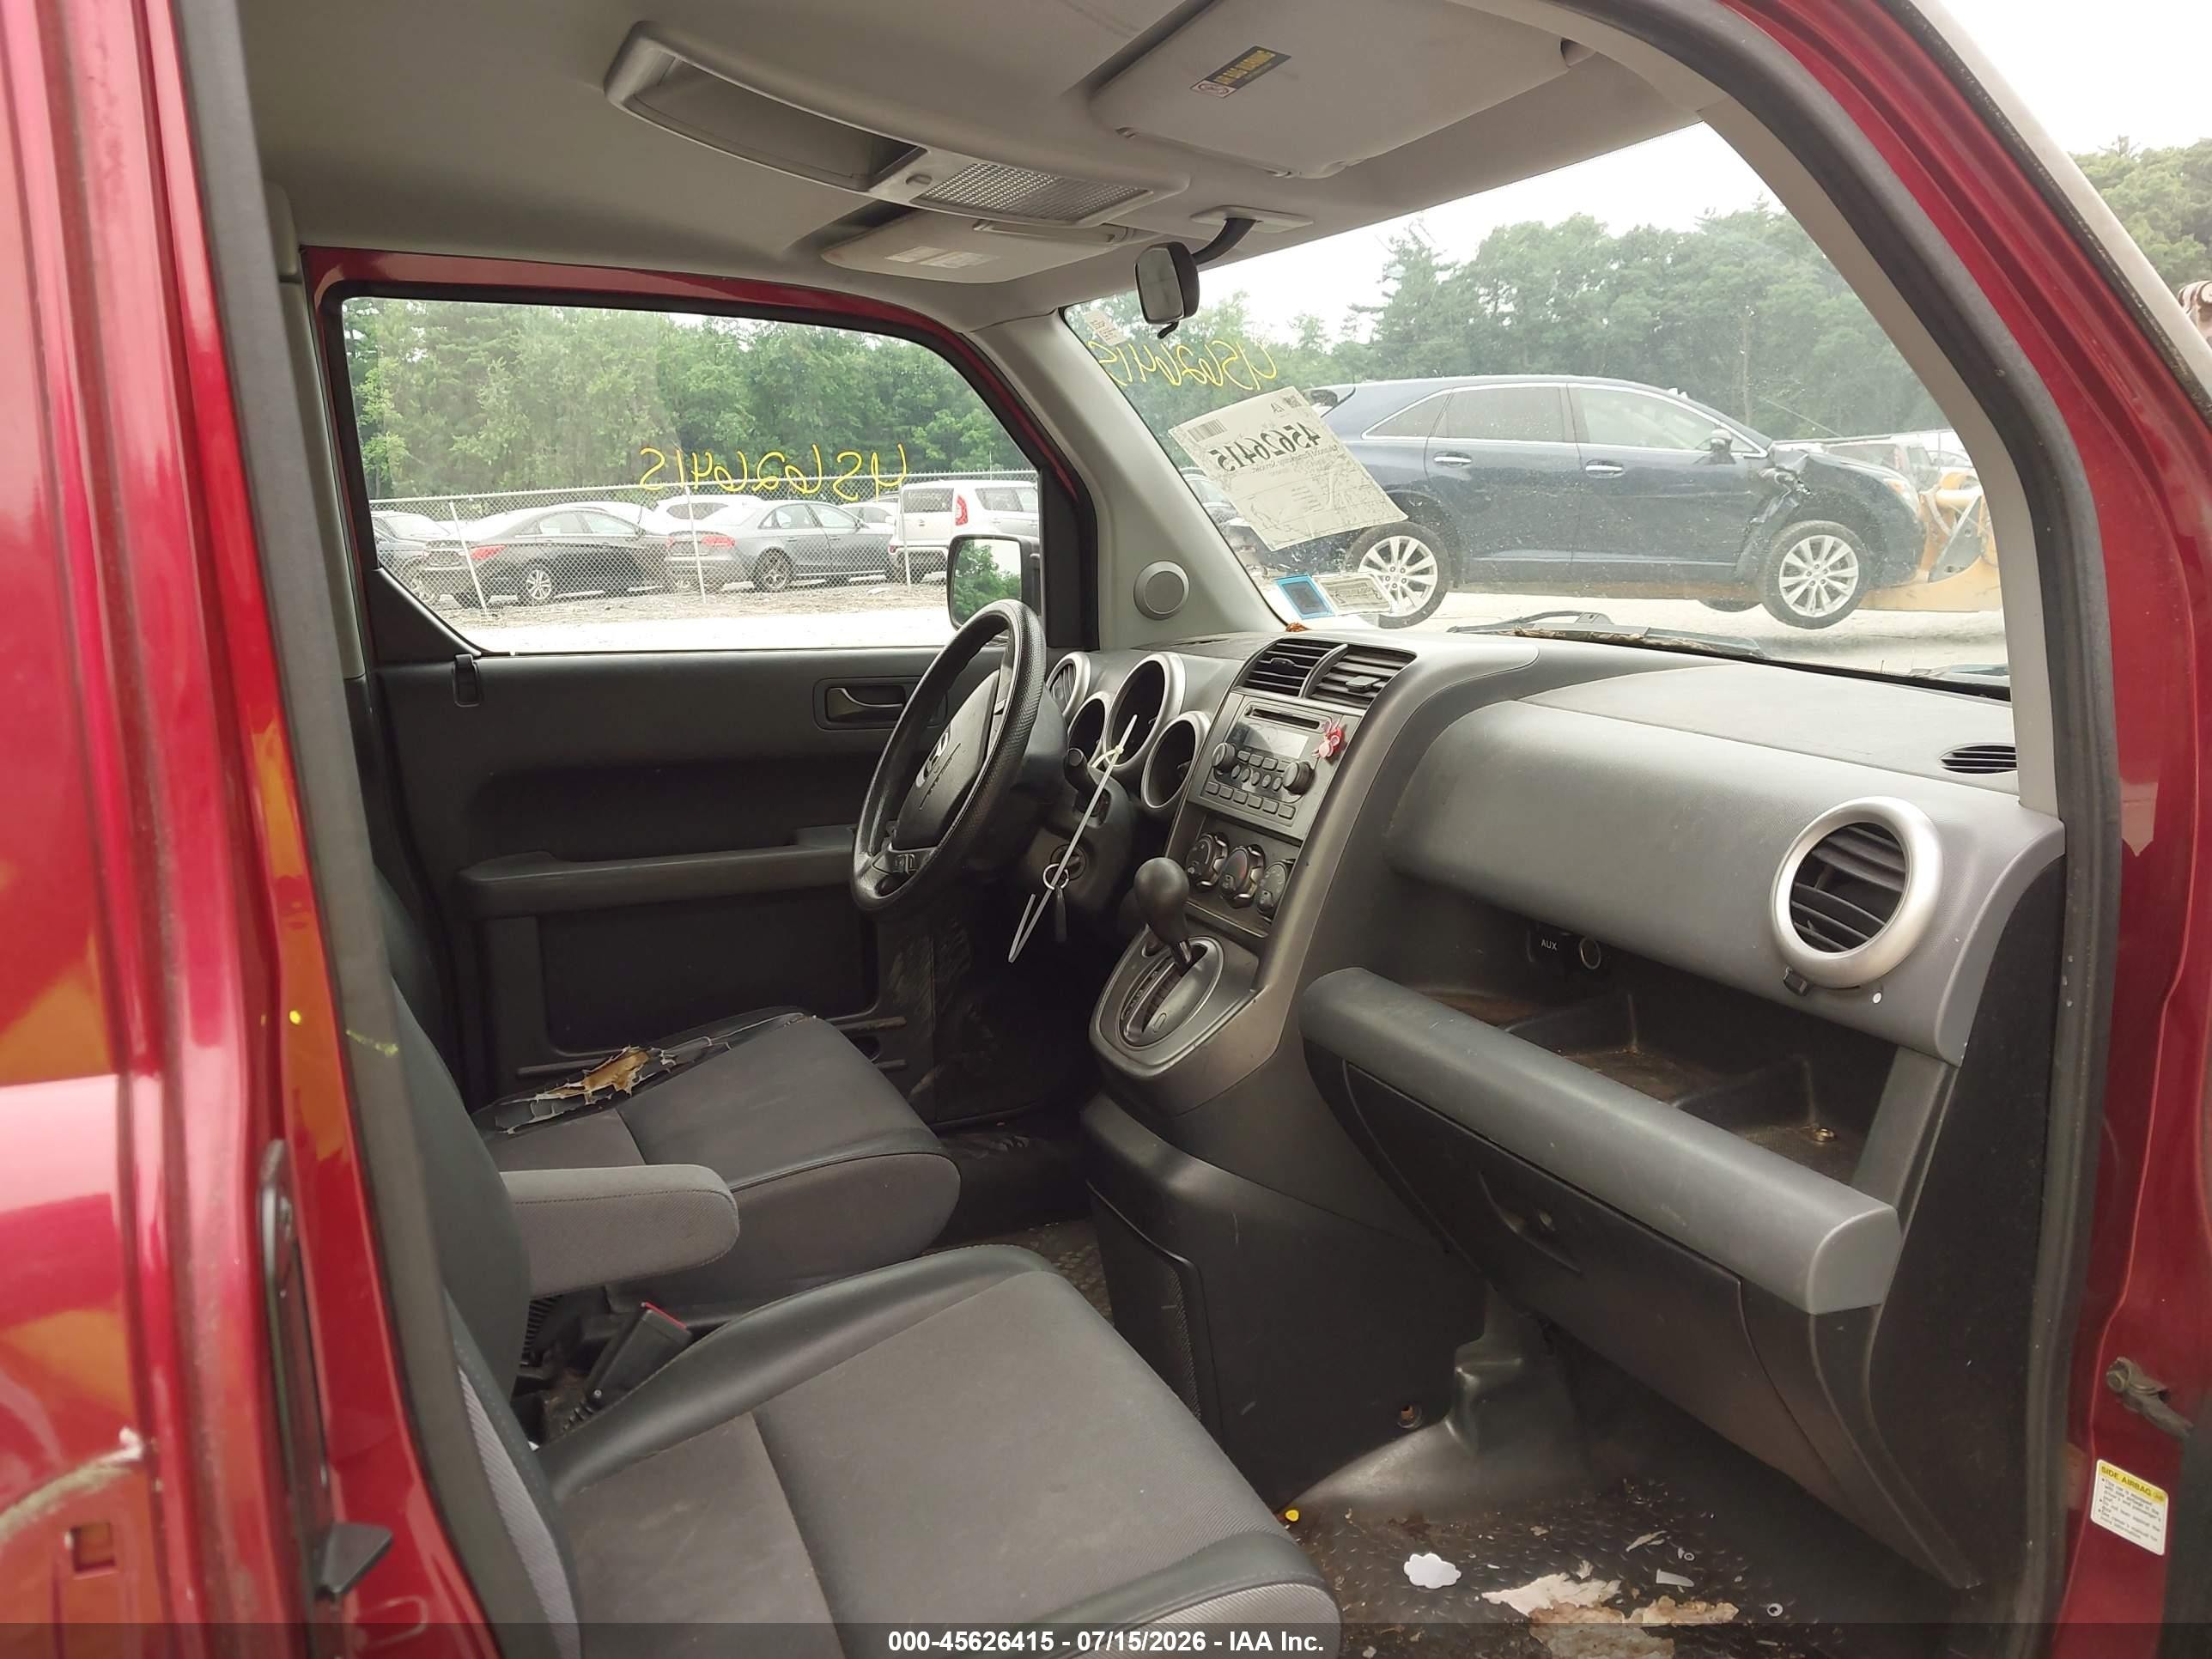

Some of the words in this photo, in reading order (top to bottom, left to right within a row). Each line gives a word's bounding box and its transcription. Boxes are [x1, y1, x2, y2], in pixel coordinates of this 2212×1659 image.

[1540, 939, 1559, 951] AUX
[2101, 1466, 2120, 1480] SIDE
[2121, 1476, 2153, 1497] AIRBAG
